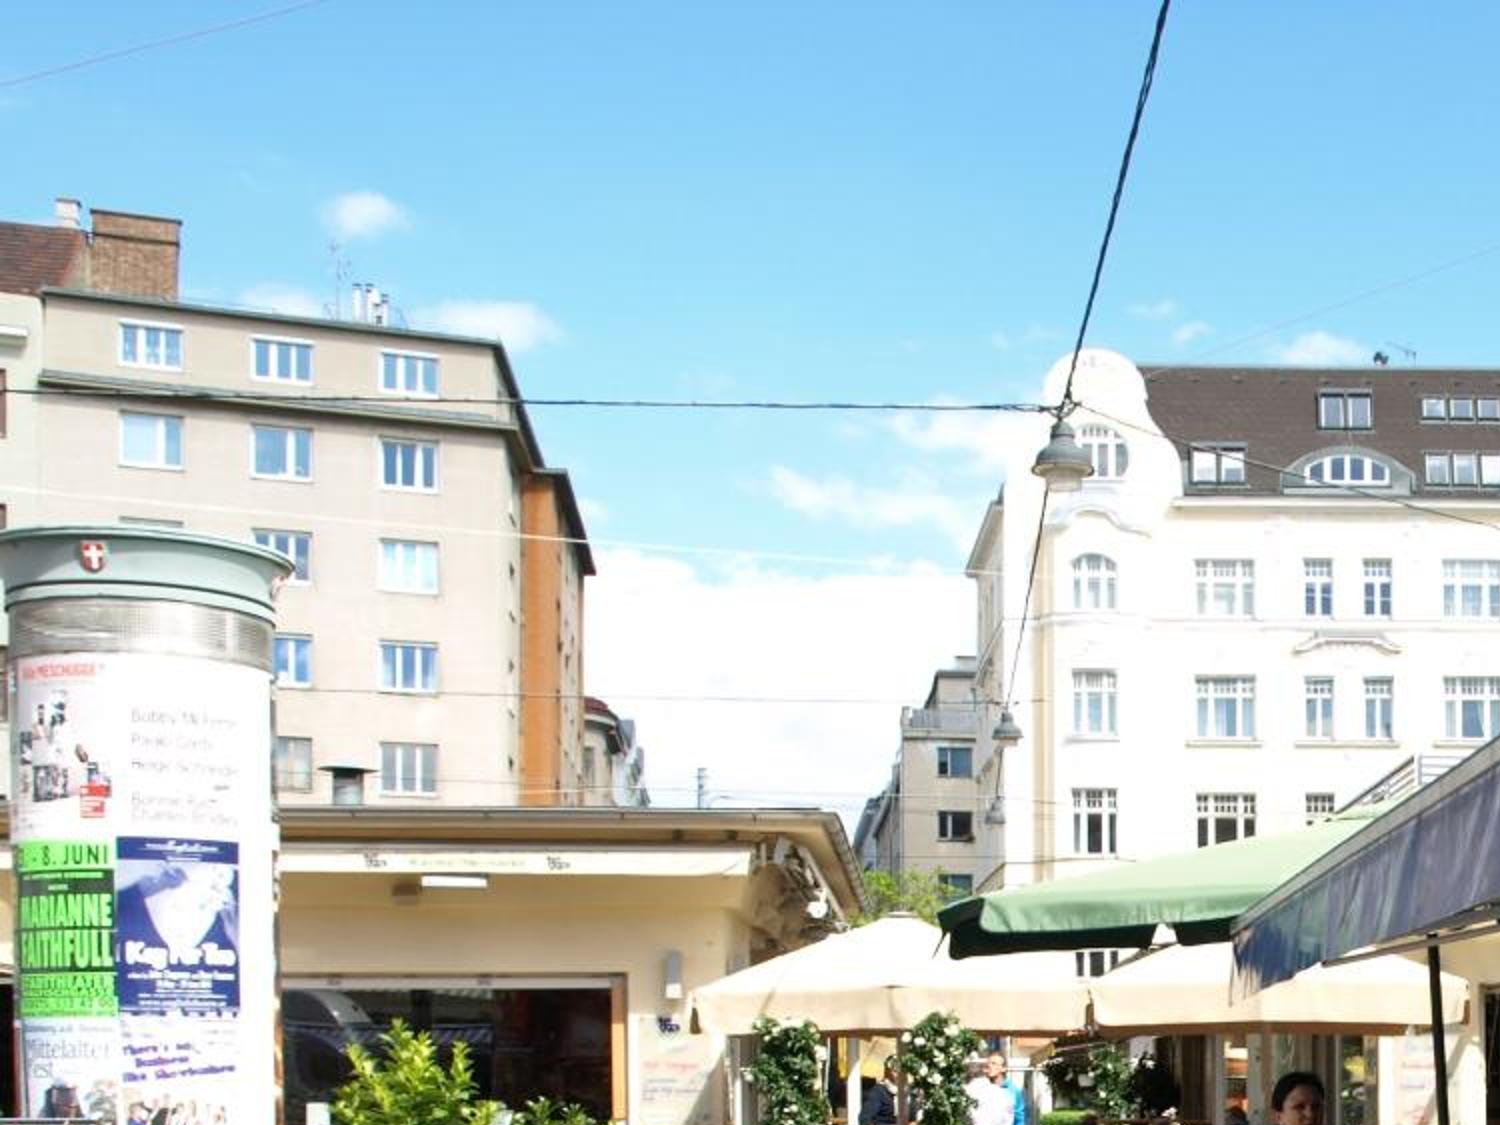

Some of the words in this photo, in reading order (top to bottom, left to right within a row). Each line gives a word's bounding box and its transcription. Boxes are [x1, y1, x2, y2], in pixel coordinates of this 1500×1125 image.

[63, 845, 109, 865] JUNI
[21, 893, 113, 928] MARIANNE
[22, 929, 114, 969] FAITHFULL
